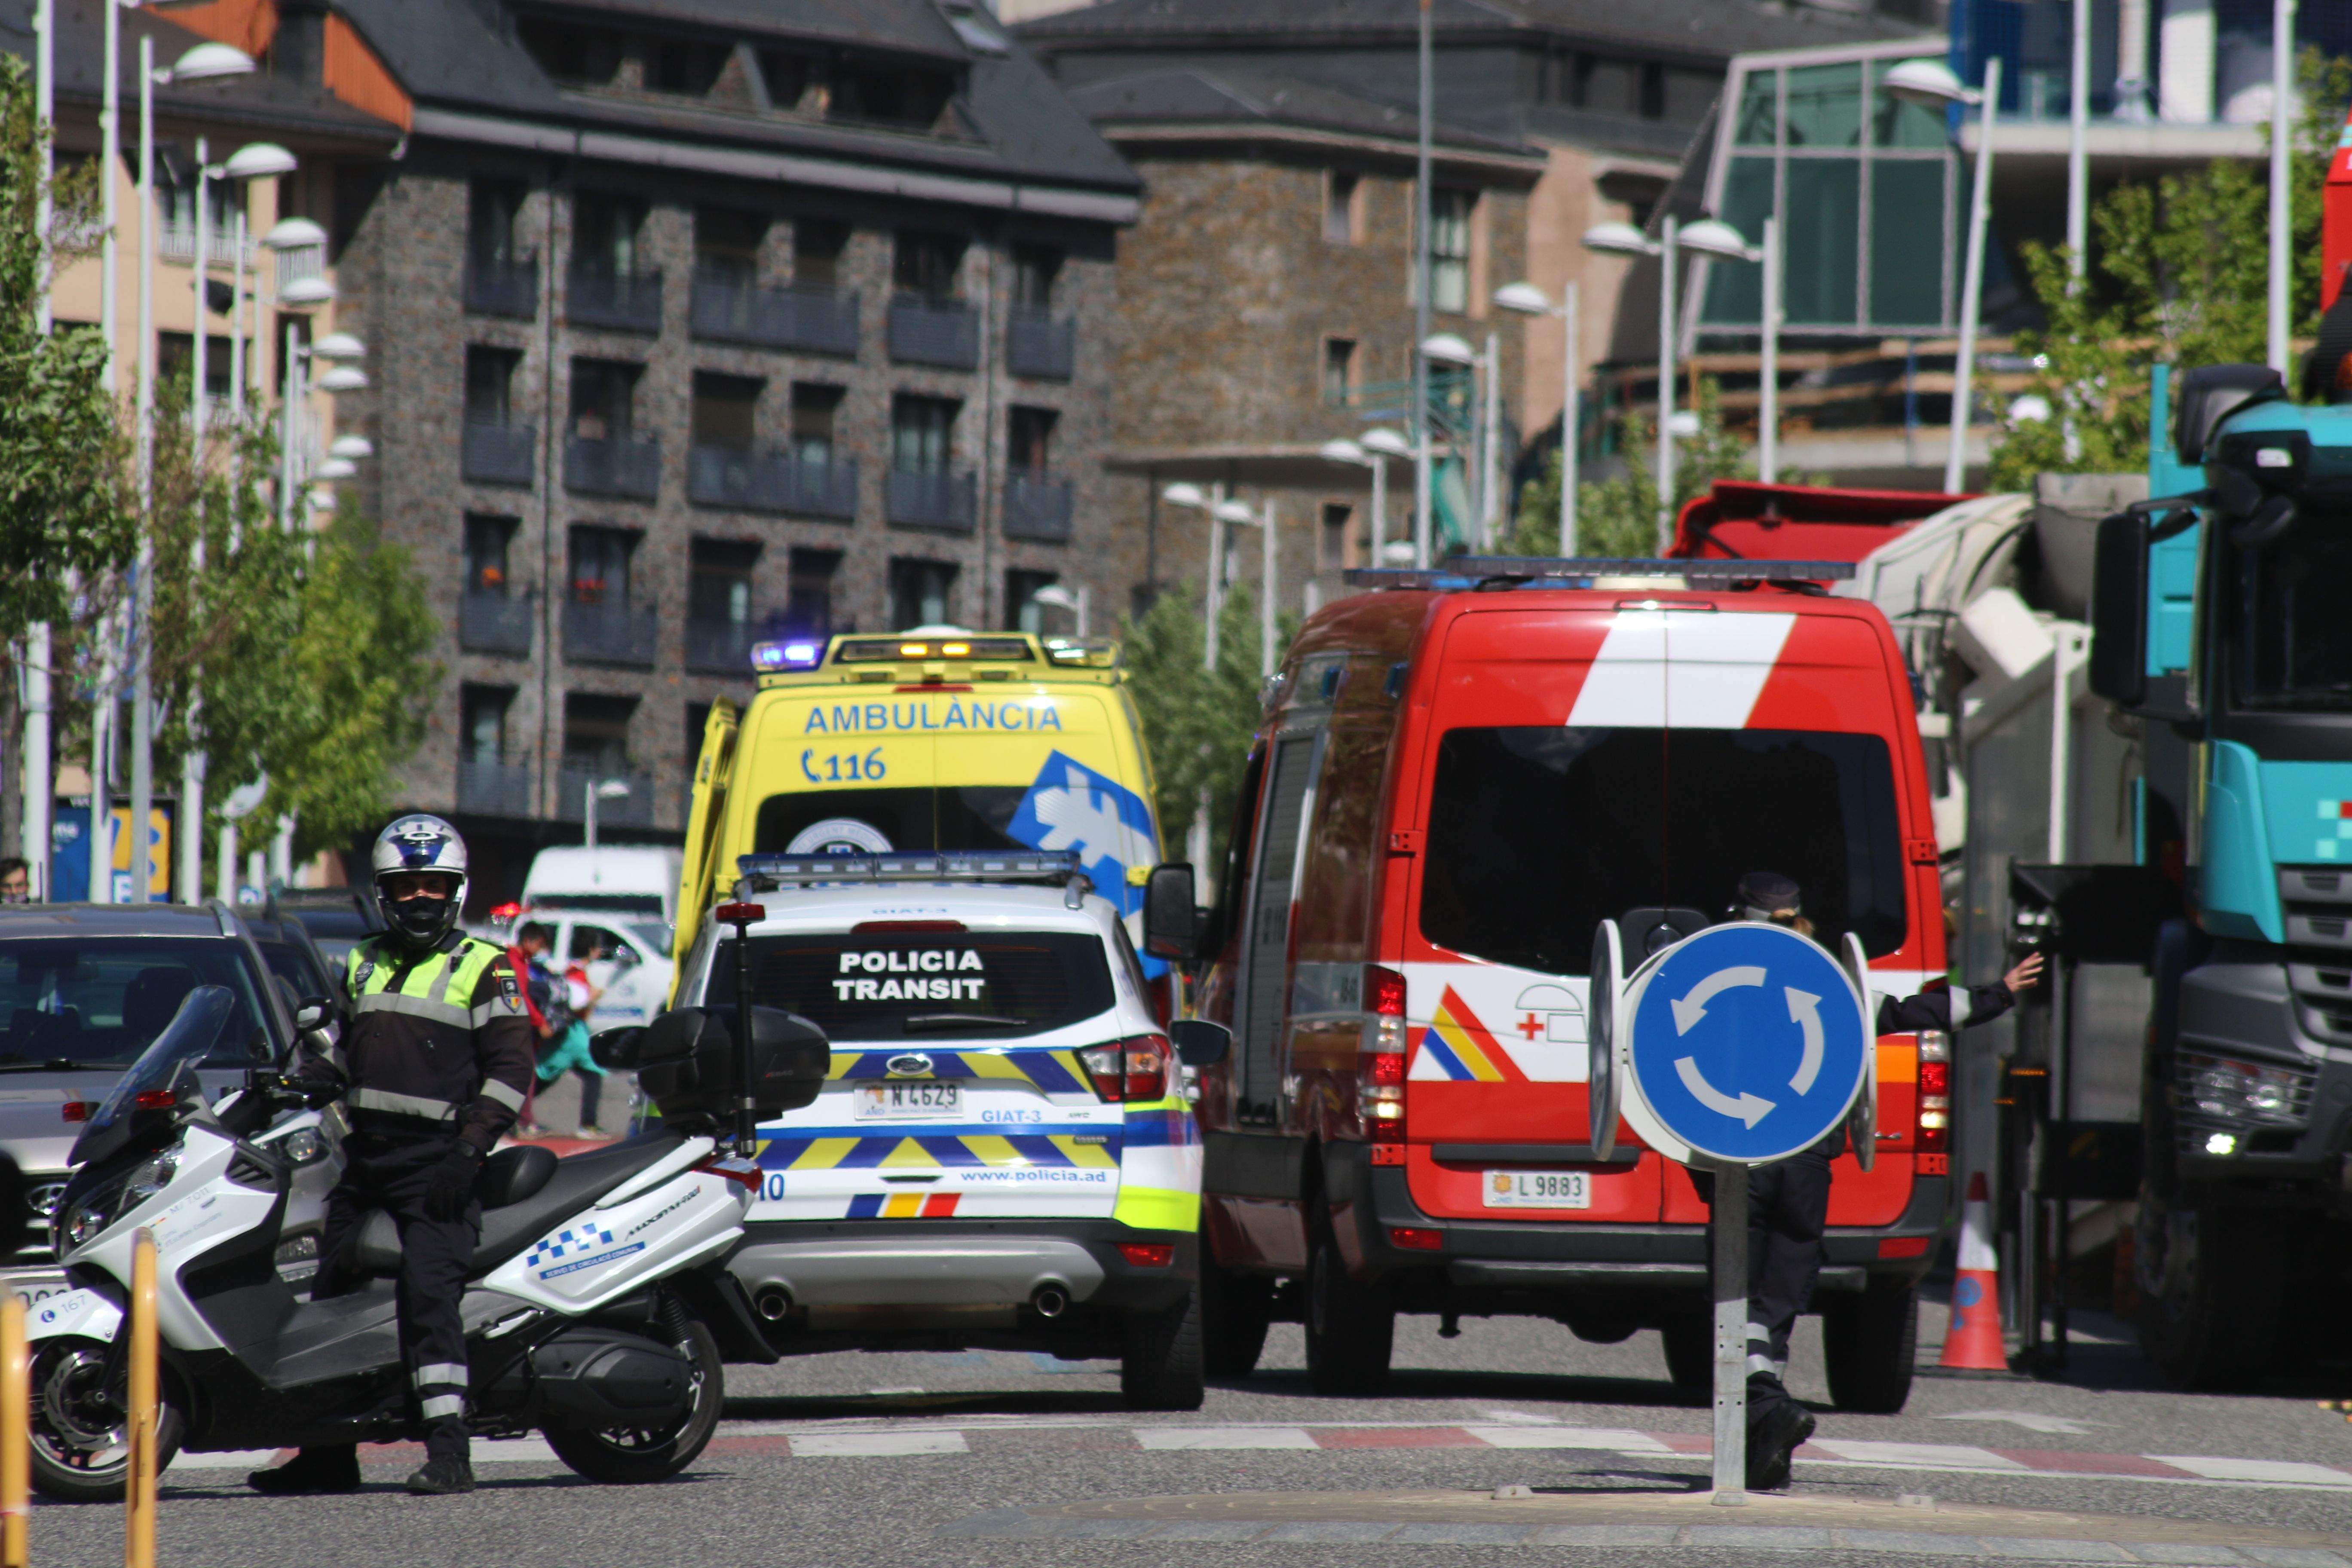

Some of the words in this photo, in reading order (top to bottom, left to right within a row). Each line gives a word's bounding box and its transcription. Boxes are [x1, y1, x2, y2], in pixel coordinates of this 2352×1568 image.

[804, 696, 1062, 734] AMBULÀNCIA
[824, 747, 886, 781] 116
[839, 949, 983, 974] POLICIA
[832, 978, 985, 1001] TRANSIT
[981, 1109, 1042, 1123] GIAT-3
[961, 1170, 1106, 1182] www.policia.ad
[1535, 1176, 1582, 1197] 9883
